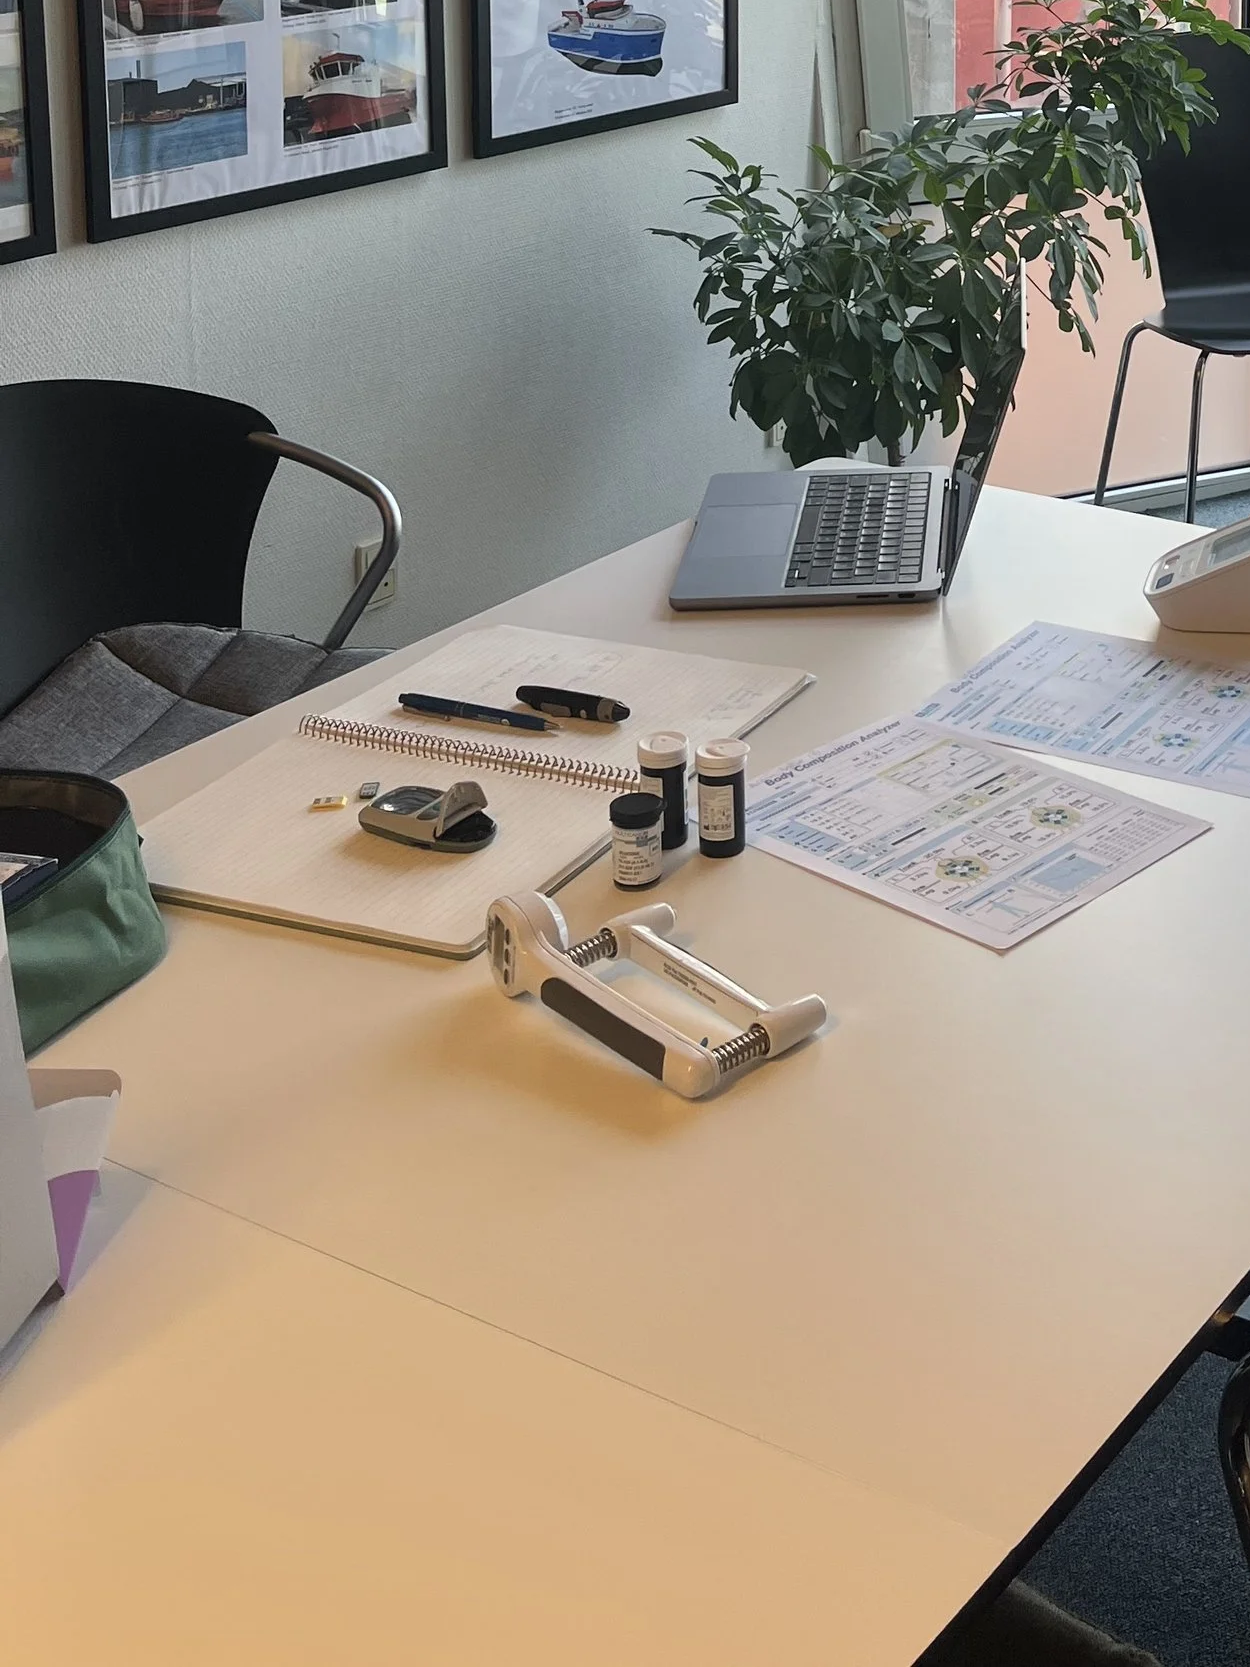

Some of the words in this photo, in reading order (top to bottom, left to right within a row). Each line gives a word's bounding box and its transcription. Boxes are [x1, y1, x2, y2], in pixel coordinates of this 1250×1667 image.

[764, 770, 795, 787] Body
[794, 738, 860, 773] Composition
[859, 719, 902, 743] Analyzer
